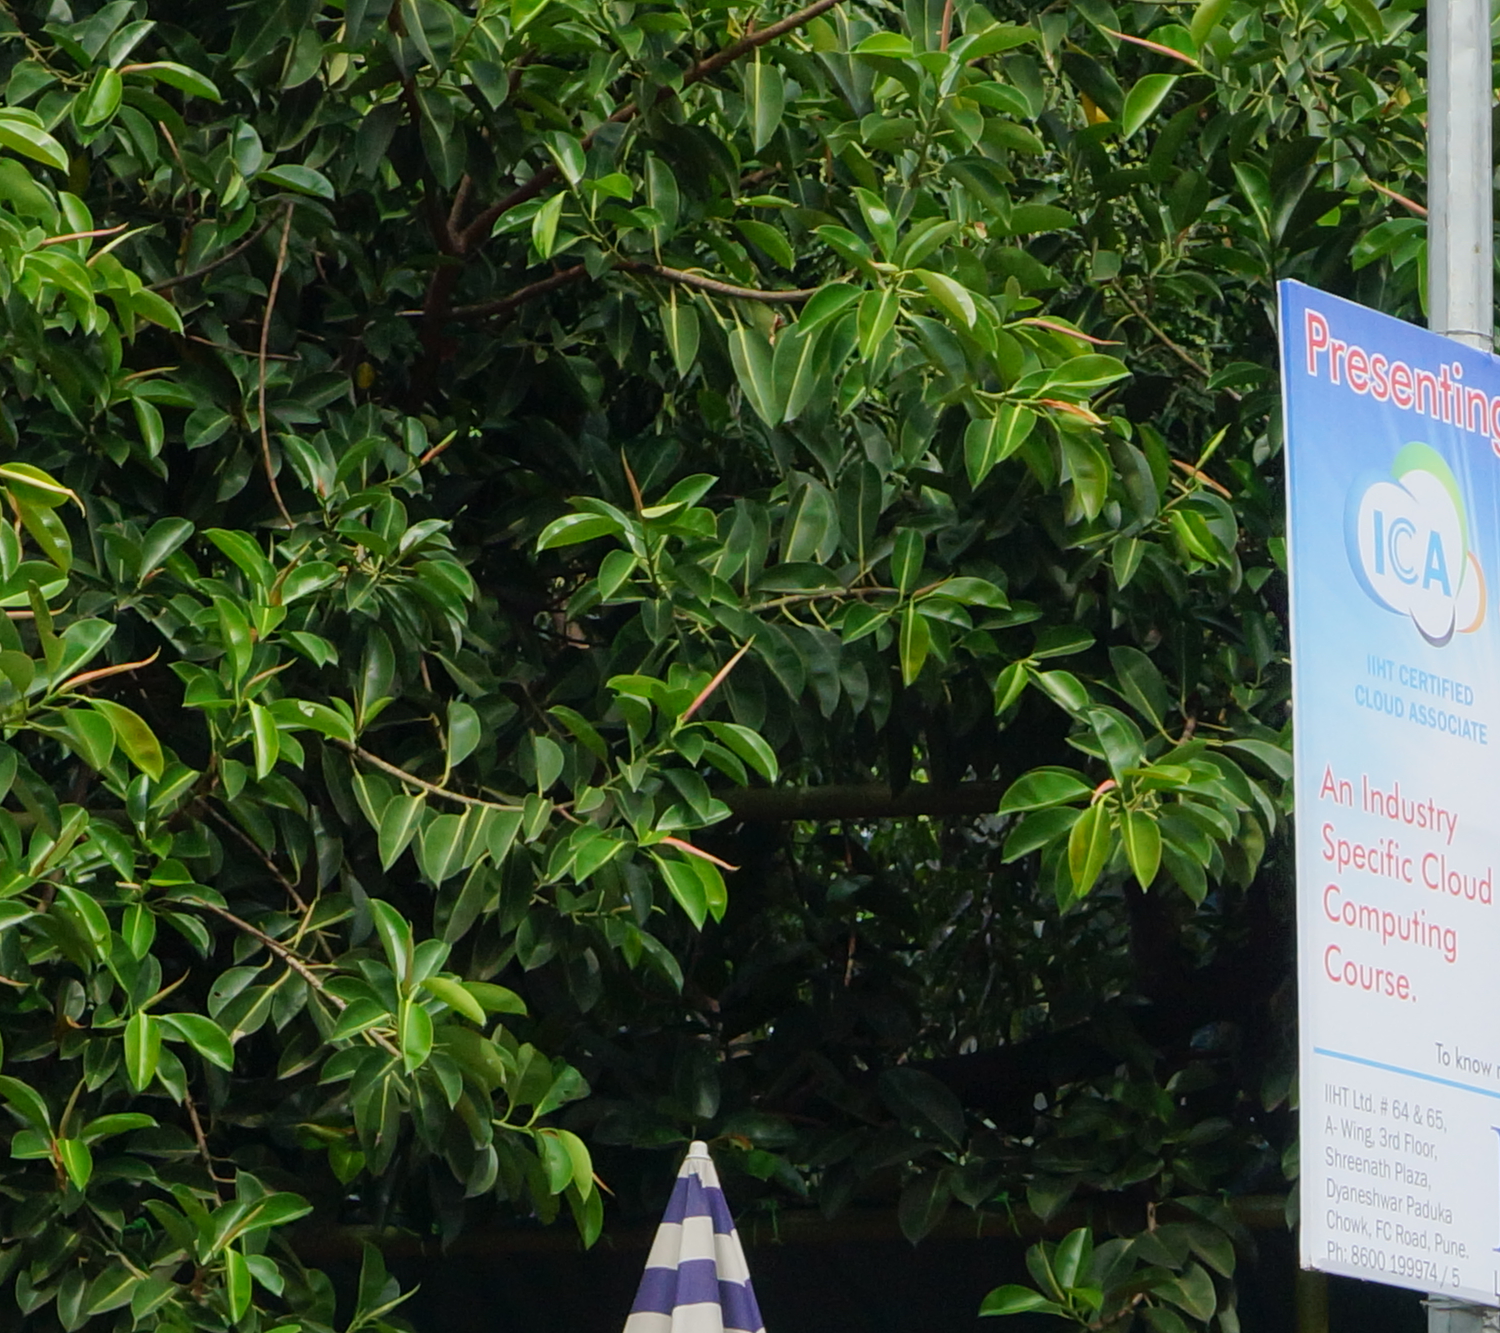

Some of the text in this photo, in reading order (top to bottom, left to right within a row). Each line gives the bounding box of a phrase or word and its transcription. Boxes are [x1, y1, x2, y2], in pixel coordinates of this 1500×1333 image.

[1372, 509, 1452, 598] ICA
[1366, 653, 1473, 706] IIHT CERTIFIED
[1354, 684, 1488, 745] CLOUD ASSOCIATE
[1320, 764, 1458, 846] An Industry
[1322, 822, 1492, 905] Specific Cloud
[1323, 884, 1457, 963] Computing
[1324, 944, 1417, 1002] Course.
[1435, 1042, 1451, 1067] To
[1455, 1046, 1492, 1077] know
[1325, 1083, 1448, 1134] IIHT Ltd. # 64 & 65,
[1325, 1146, 1432, 1192] Shreenath Plaza,
[1379, 1127, 1400, 1151] 3rd
[1404, 1132, 1438, 1162] Floor,
[1326, 1177, 1453, 1225] Dyaneshwar Paduka
[1326, 1208, 1470, 1260] Chowk, FC Road, Pune.
[1351, 1244, 1386, 1272] 8600
[1390, 1254, 1438, 1283] 199974
[1452, 1268, 1461, 1289] 5
